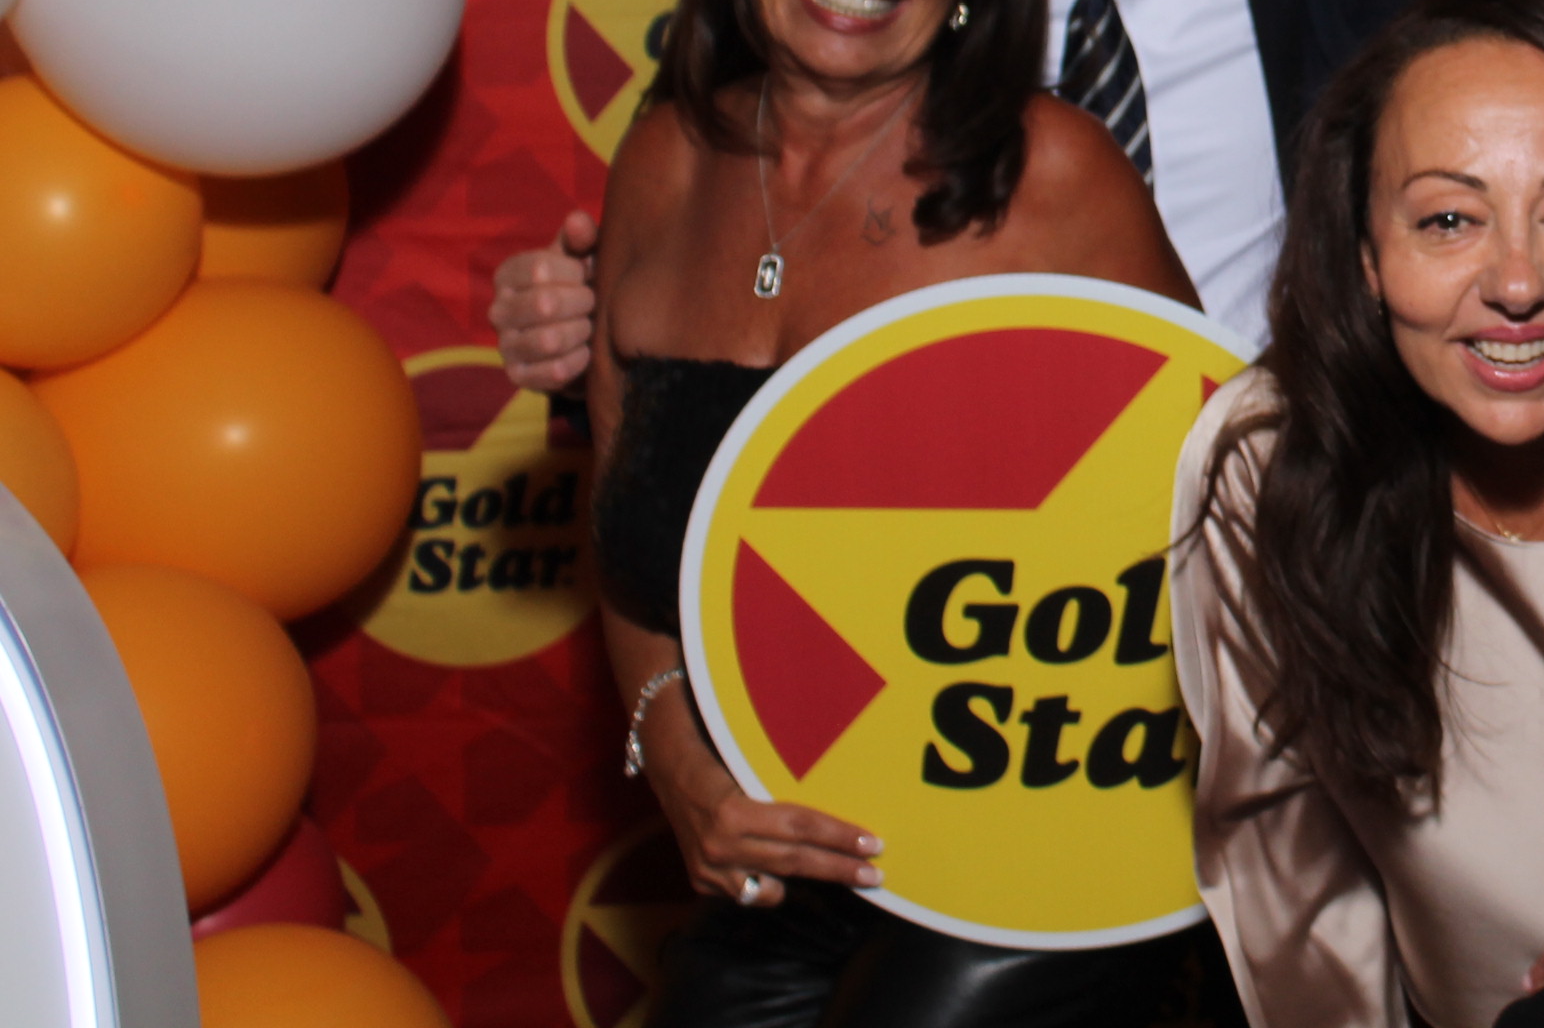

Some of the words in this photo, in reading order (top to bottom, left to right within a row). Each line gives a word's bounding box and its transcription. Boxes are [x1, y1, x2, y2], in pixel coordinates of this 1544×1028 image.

[409, 472, 578, 530] Gold
[409, 539, 577, 594] Star
[904, 557, 1169, 665] Gol
[921, 681, 1200, 790] Sta
